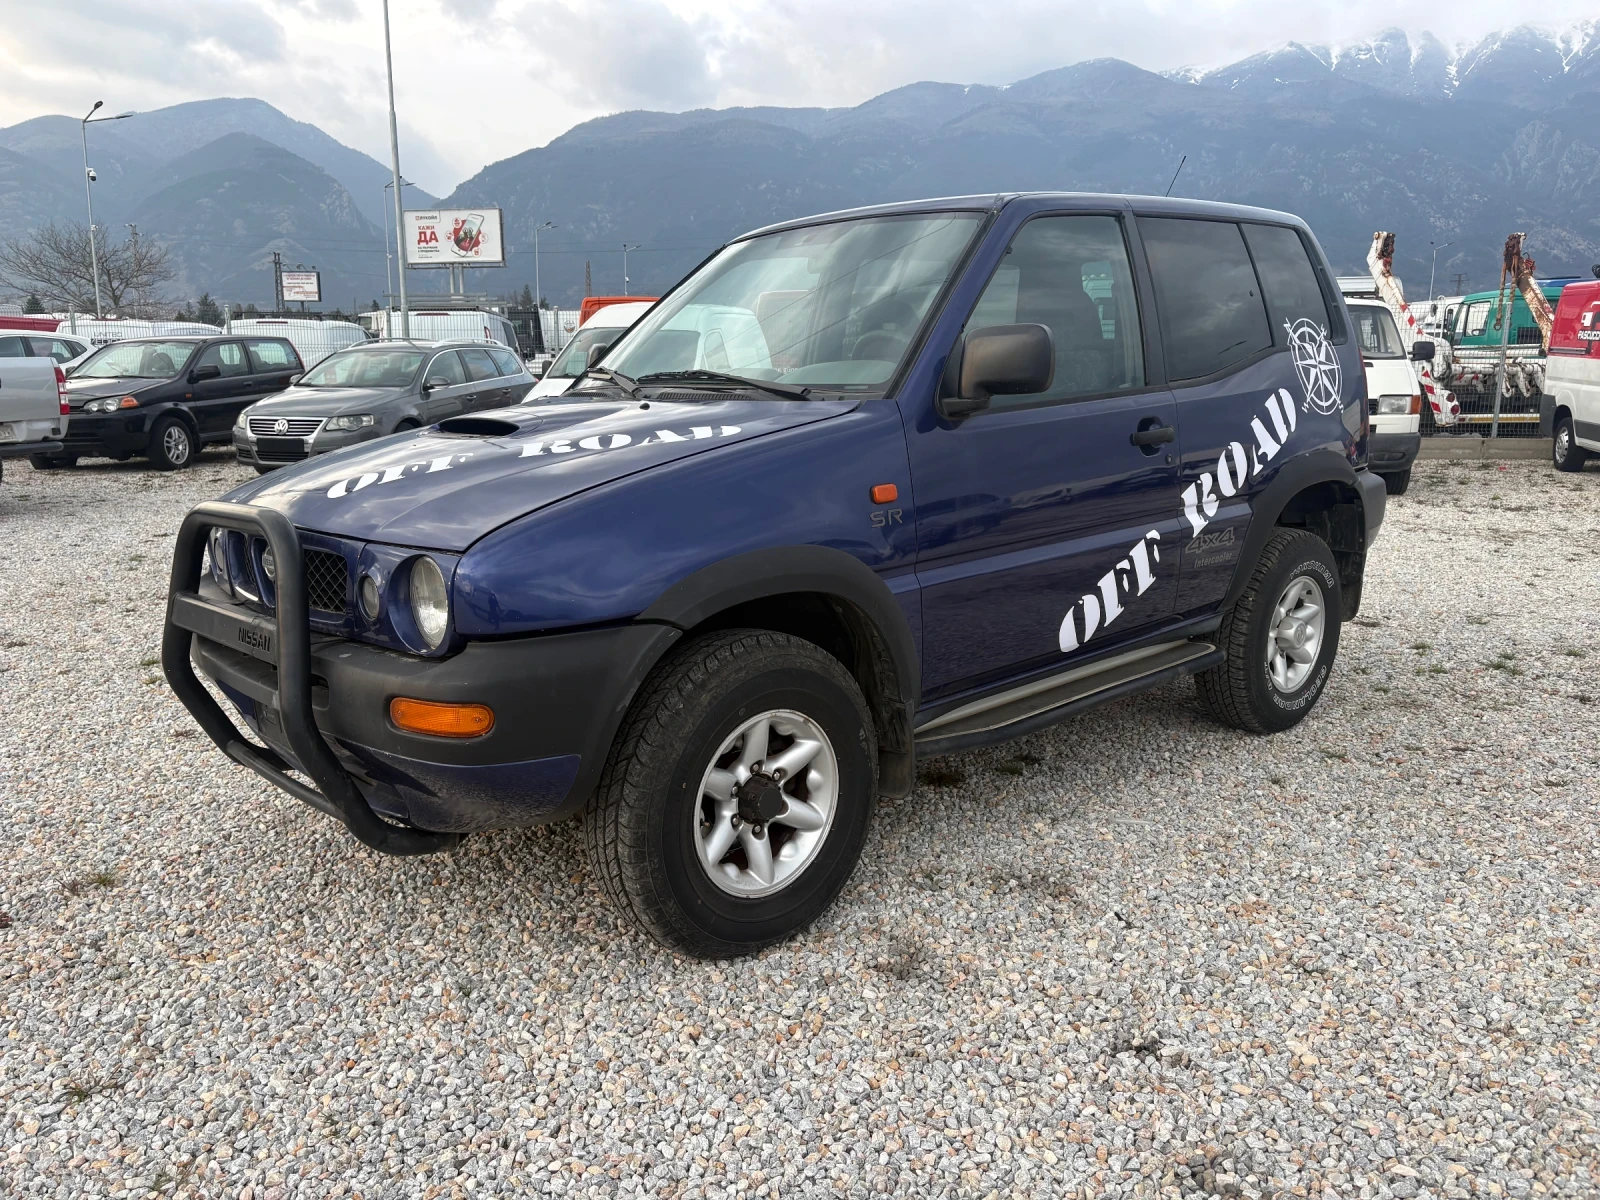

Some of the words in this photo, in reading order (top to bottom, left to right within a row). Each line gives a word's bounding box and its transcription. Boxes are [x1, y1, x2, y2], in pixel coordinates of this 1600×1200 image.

[417, 231, 439, 245] ДА
[327, 452, 474, 499] OFF
[518, 425, 742, 458] ROAD
[870, 508, 903, 528] SR
[1058, 529, 1161, 653] OFF
[1181, 388, 1297, 538] ROAD
[1185, 526, 1235, 554] 4x4
[1194, 551, 1232, 569] Intercooler
[238, 626, 271, 653] NISSAN
